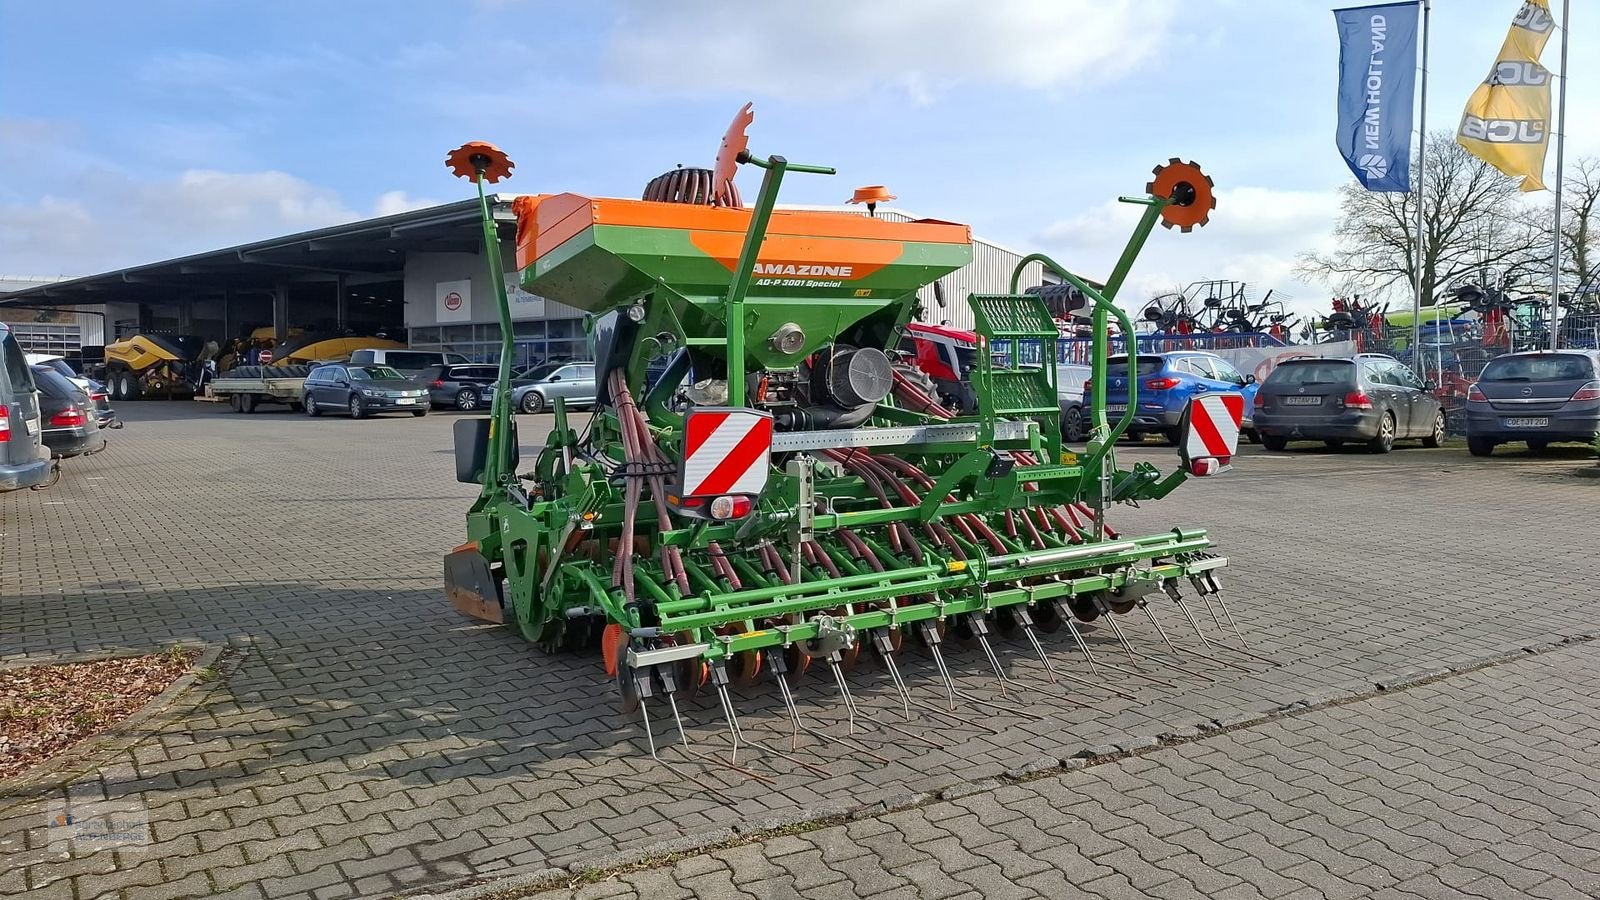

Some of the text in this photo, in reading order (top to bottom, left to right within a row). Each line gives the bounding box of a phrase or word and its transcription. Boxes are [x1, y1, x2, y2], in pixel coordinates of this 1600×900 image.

[753, 263, 853, 277] AMAZONE
[782, 279, 805, 287] 3001
[805, 280, 842, 288] Special
[1525, 418, 1534, 426] JT
[1535, 418, 1548, 426] 201
